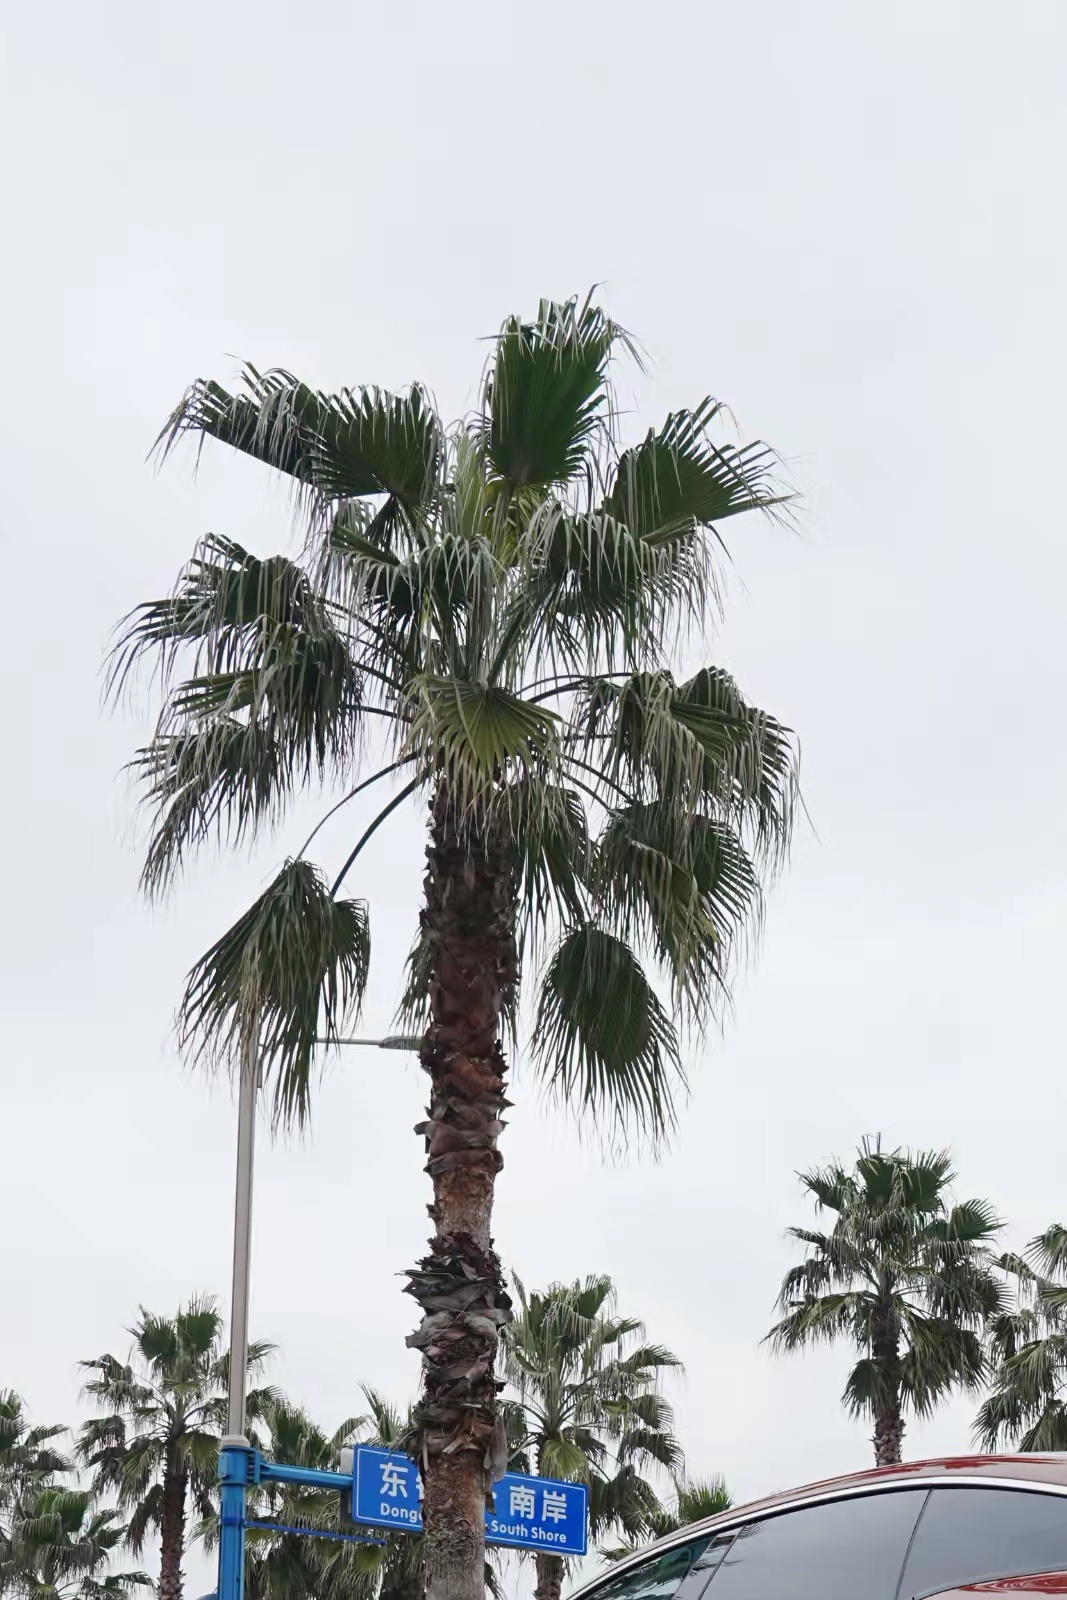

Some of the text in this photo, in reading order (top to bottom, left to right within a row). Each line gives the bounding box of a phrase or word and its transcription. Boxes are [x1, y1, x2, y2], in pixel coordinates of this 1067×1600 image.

[509, 1485, 567, 1524] 南岸
[491, 1520, 528, 1538] South
[531, 1526, 567, 1543] Shore
